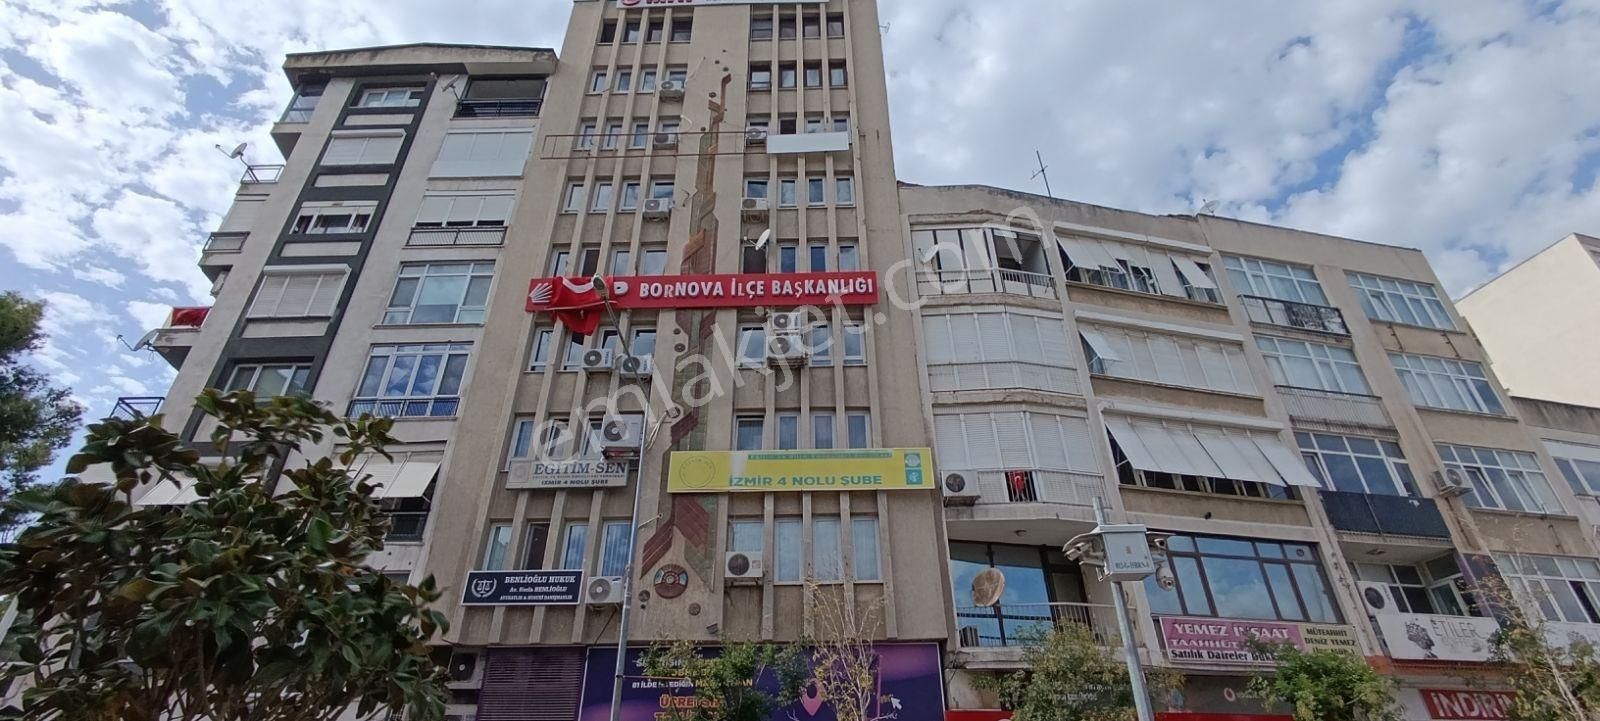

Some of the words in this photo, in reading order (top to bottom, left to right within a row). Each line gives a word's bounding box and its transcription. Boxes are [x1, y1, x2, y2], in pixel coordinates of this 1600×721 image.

[639, 280, 723, 298] BORNOVA
[731, 277, 765, 299] İLÇE
[771, 276, 874, 299] BAŞKANLIĞI
[729, 473, 771, 487] İZMİR
[777, 476, 787, 487] 4
[792, 476, 836, 486] NOLU
[840, 475, 882, 488] ŞUBE
[504, 574, 547, 583] BENLİOĞLU
[548, 575, 576, 583] HUKUK
[1174, 623, 1230, 637] YEMEZ
[1171, 639, 1242, 649] TAAHHÜT
[1171, 649, 1204, 659] Satılık
[1207, 650, 1249, 661] Daireler
